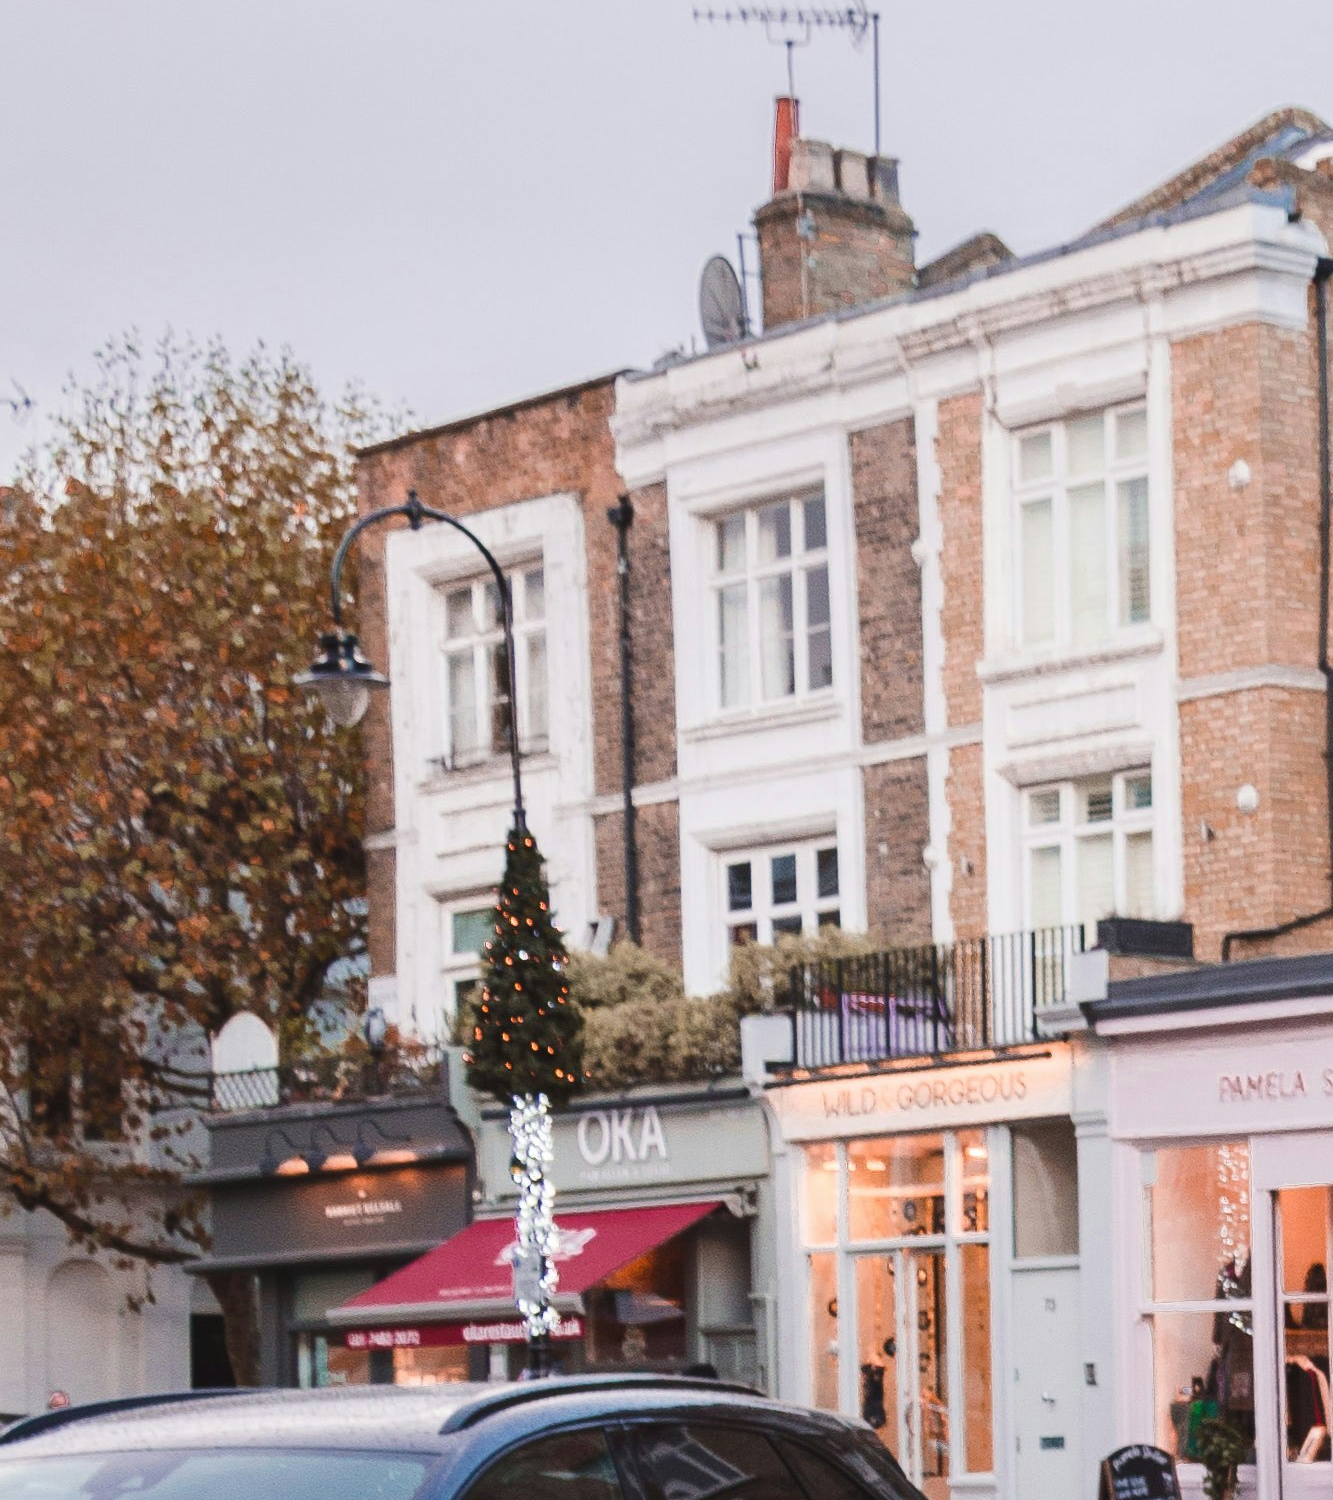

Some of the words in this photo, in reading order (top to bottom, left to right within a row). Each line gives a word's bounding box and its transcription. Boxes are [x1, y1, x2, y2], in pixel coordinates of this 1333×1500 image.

[822, 1086, 877, 1118] WILD
[896, 1071, 1027, 1111] GORGEOUS
[1218, 1069, 1307, 1104] PAMELA
[576, 1104, 667, 1167] OKA
